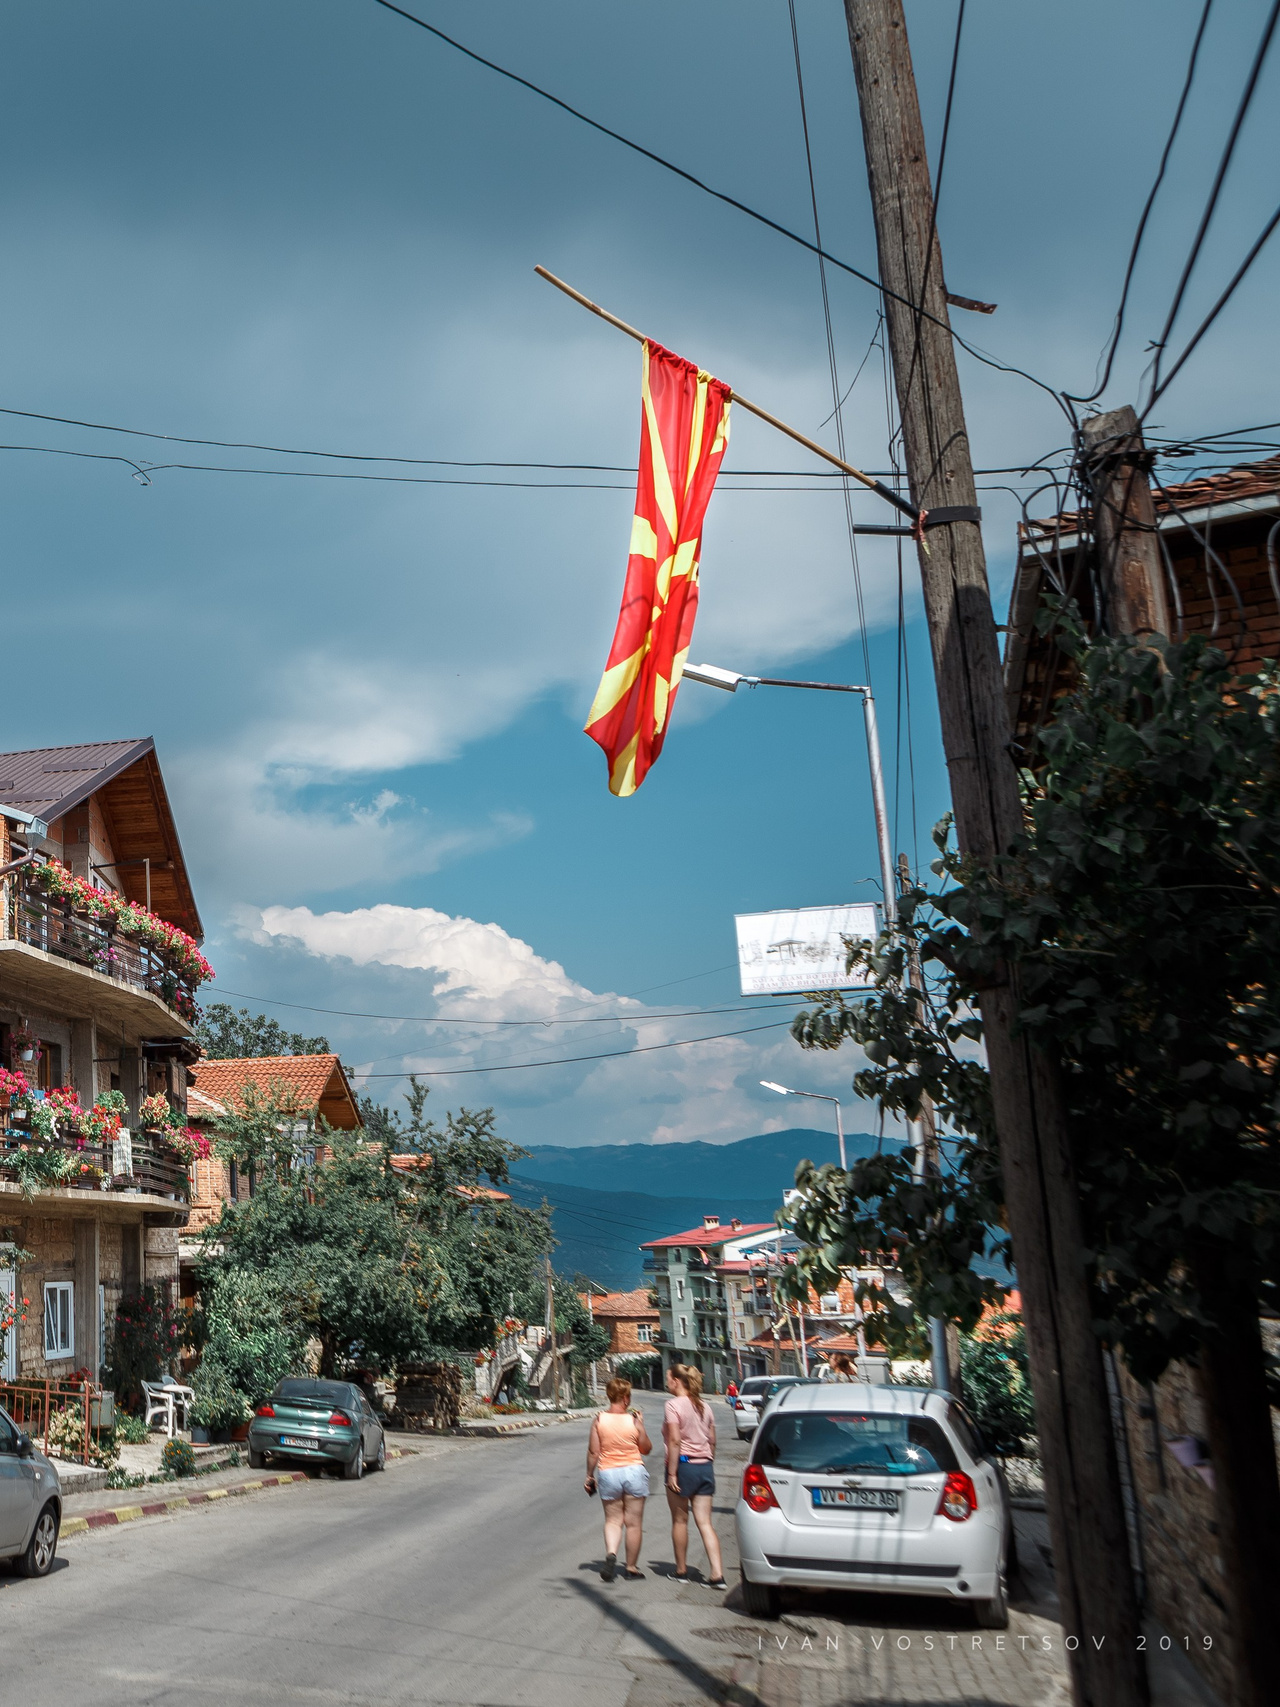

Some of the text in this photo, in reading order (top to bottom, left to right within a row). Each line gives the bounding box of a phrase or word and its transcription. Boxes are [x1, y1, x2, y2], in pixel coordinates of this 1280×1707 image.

[820, 1488, 895, 1506] VV 0792 AB
